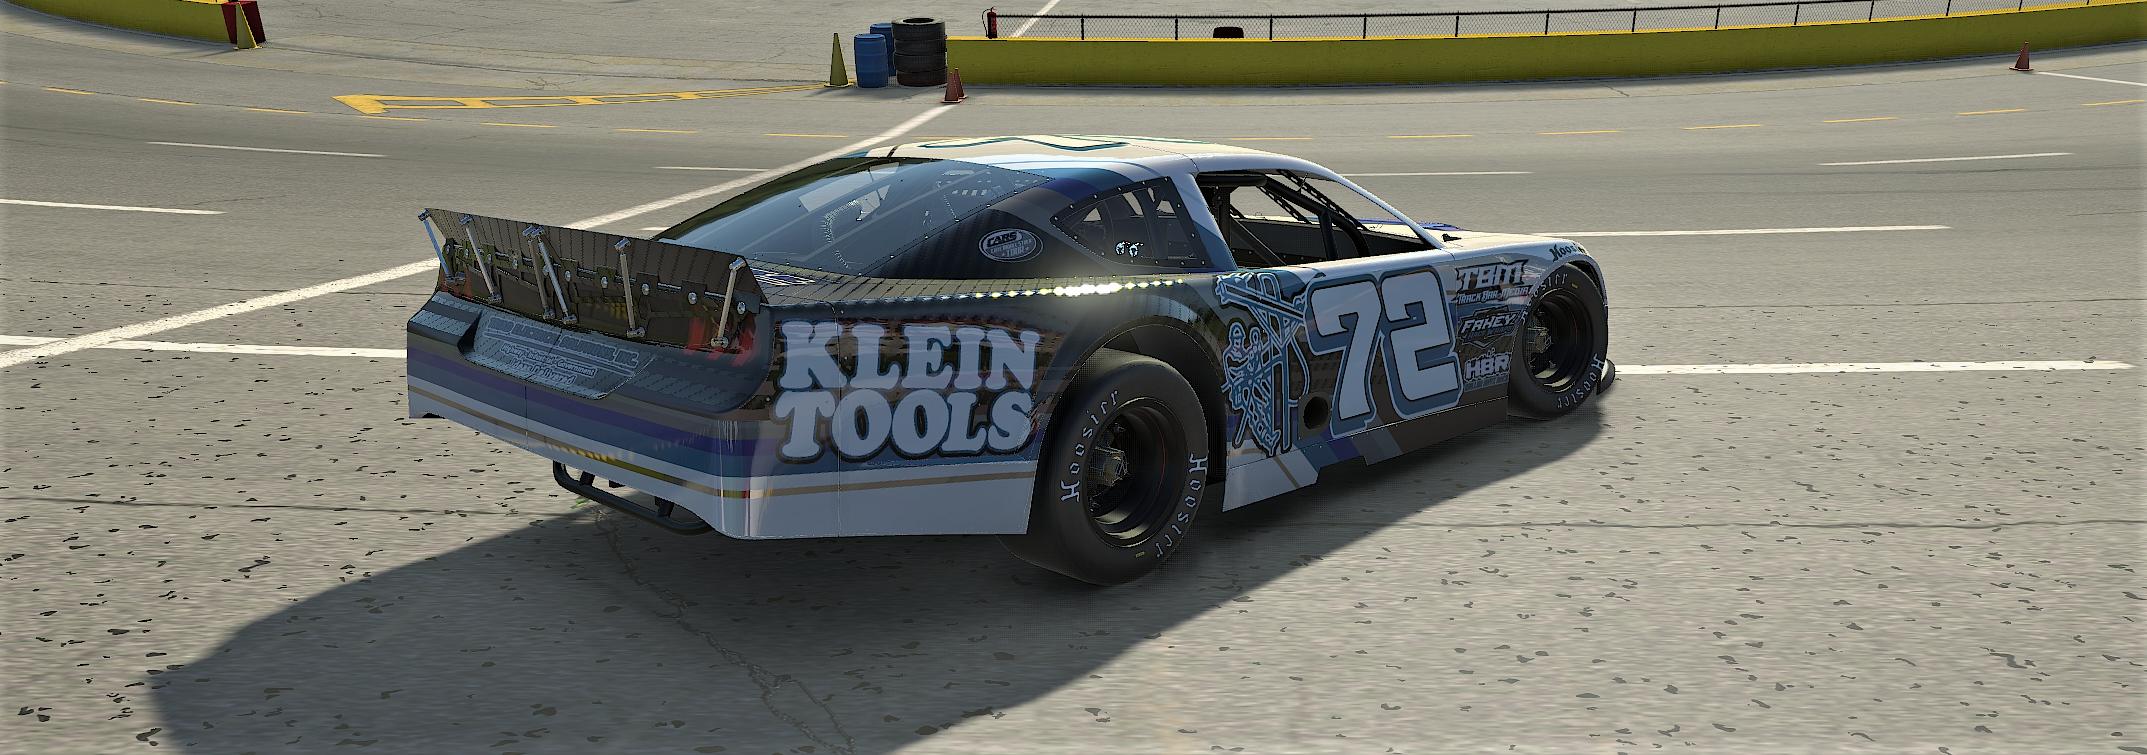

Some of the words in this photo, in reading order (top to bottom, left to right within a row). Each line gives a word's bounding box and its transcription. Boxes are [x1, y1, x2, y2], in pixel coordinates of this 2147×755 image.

[1456, 259, 1528, 292] TBM
[779, 320, 1040, 391] KLEIN
[1304, 267, 1461, 434] 72
[1465, 354, 1510, 380] HBR
[774, 389, 1034, 459] TOOLS
